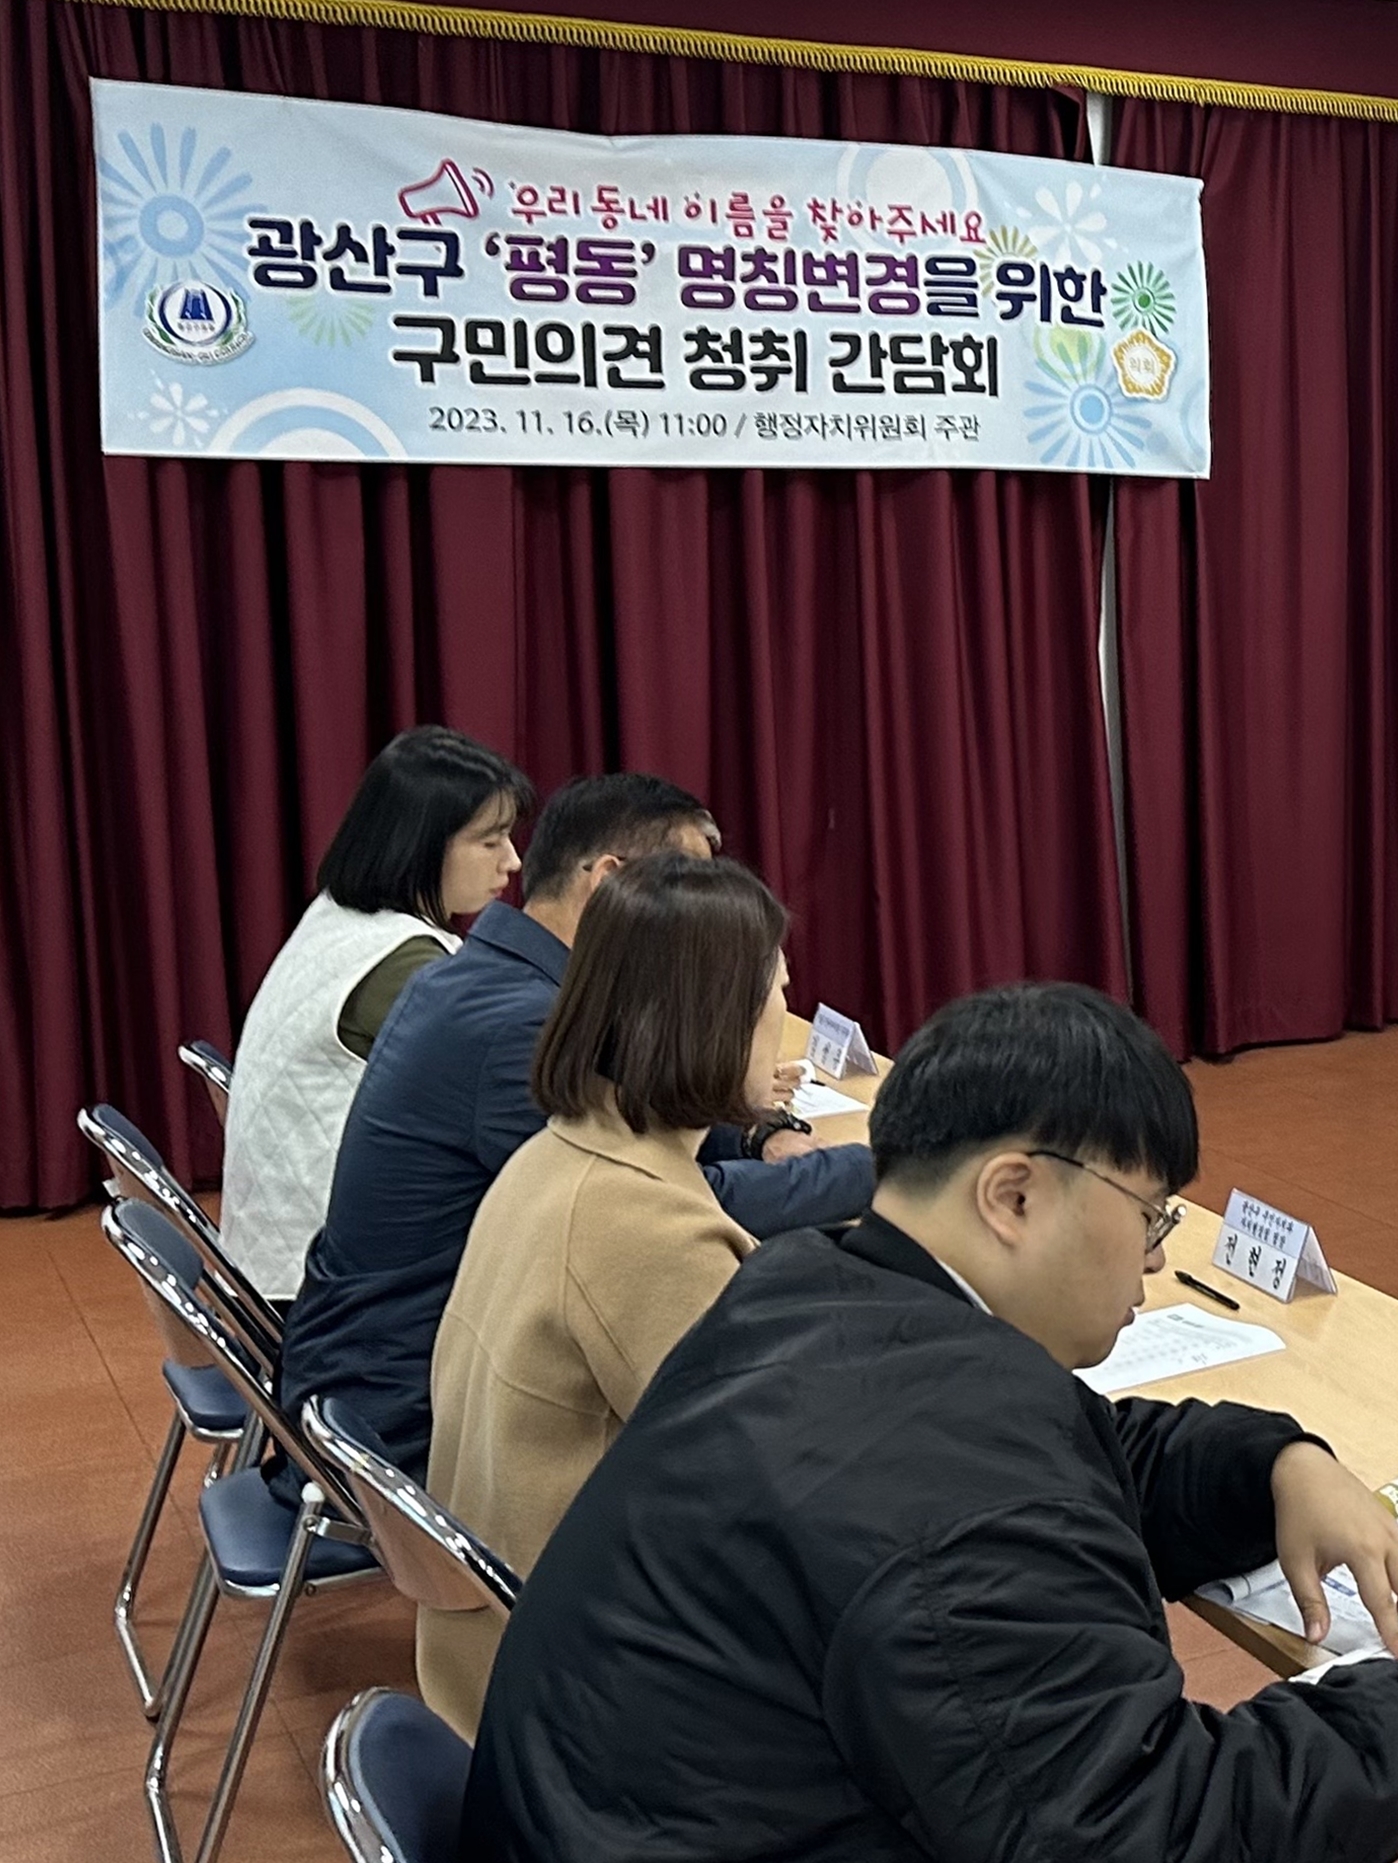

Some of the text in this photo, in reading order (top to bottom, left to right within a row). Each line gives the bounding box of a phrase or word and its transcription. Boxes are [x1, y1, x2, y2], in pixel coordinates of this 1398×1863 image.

[508, 181, 986, 244] 우리 동네 이름을 찾아주세요
[247, 219, 464, 296] 광산구
[677, 244, 979, 317] 명칭변경을
[996, 262, 1107, 328] 위한
[392, 315, 999, 397] 구민의견 청취 간담회
[430, 406, 505, 433] 2023.
[518, 408, 554, 434] 11.
[564, 410, 649, 438] 16.(목)
[661, 413, 726, 437] 11:00
[755, 412, 926, 441] 행정자치위원회
[934, 414, 981, 442] 주관
